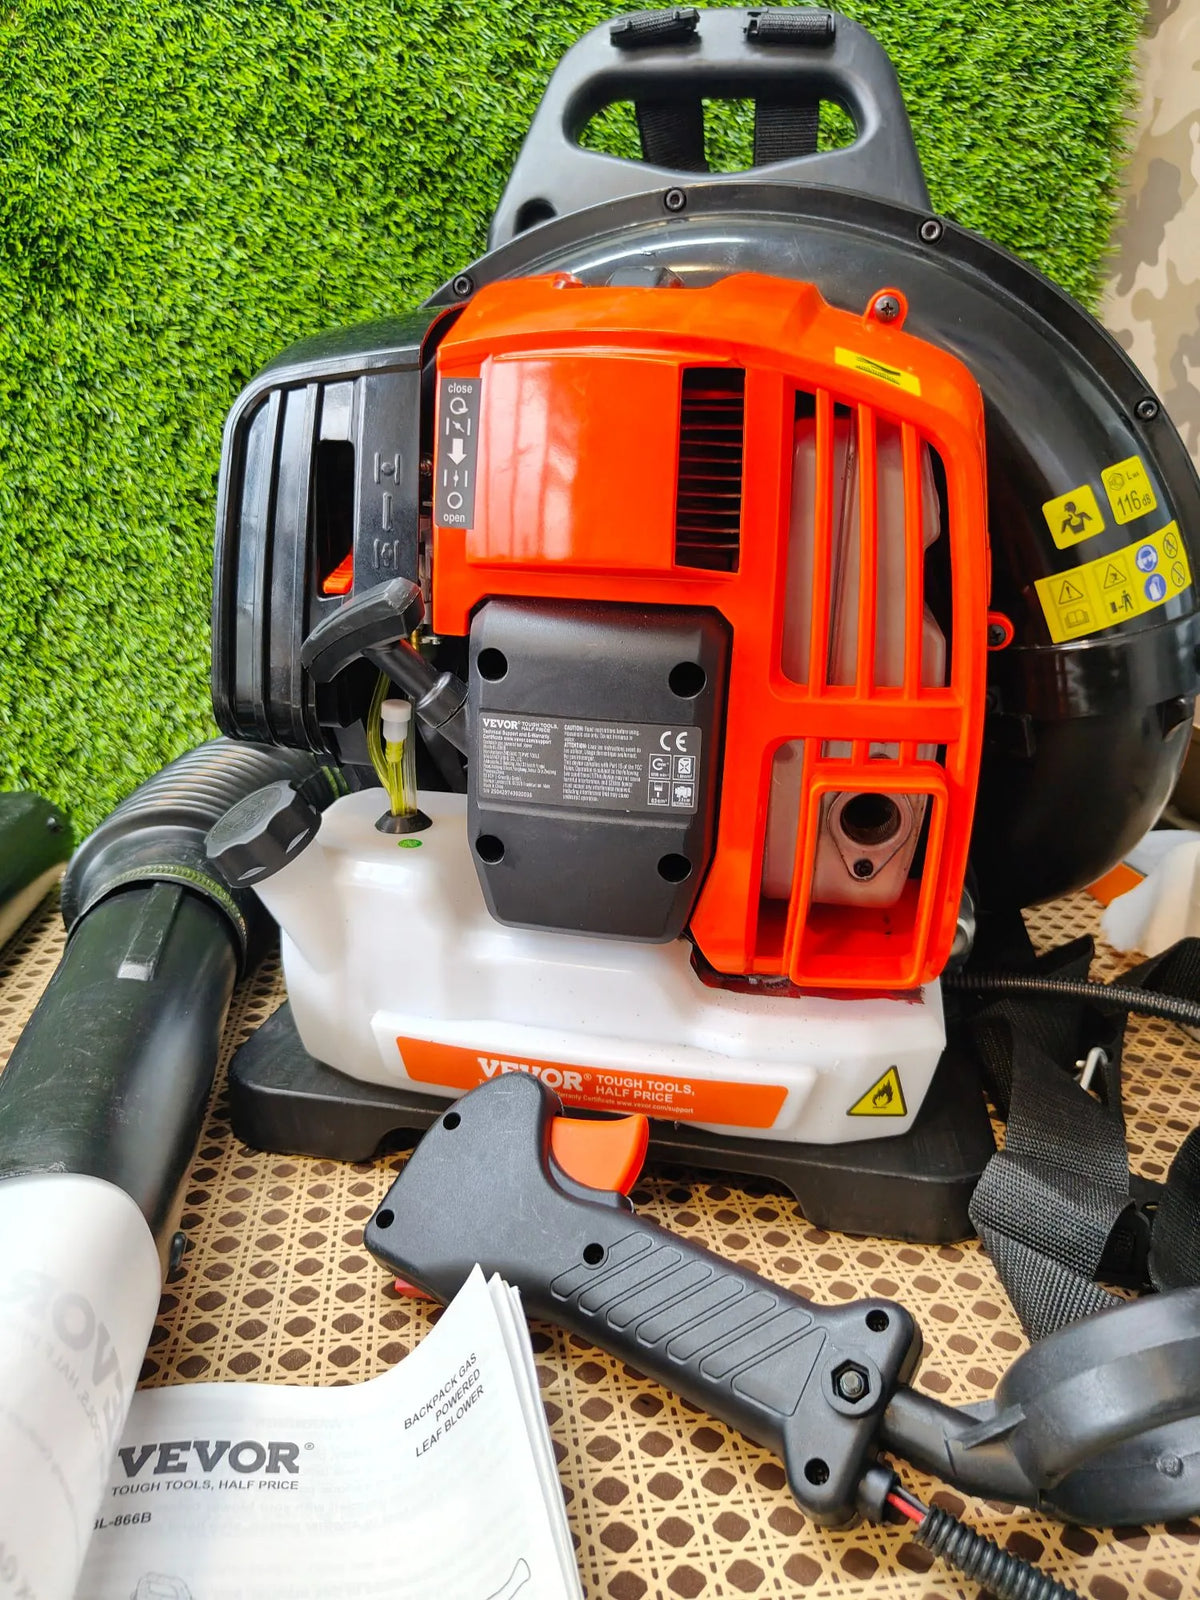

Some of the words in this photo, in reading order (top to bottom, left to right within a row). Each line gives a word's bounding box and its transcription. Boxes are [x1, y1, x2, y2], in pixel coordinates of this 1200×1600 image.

[448, 383, 473, 394] close
[1117, 490, 1142, 516] 116
[443, 513, 466, 524] open
[483, 718, 518, 730] VEVOR
[659, 730, 688, 752] CE
[595, 1085, 630, 1097] HALF
[633, 1090, 673, 1103] PRICE
[596, 1074, 643, 1089] TOUGH
[646, 1080, 695, 1096] TOOLS,
[583, 1095, 615, 1105] Certificate
[616, 1100, 694, 1114] www.vevor.com/support
[404, 1374, 458, 1430] BACKPACK
[458, 1352, 478, 1378] GAS
[435, 1368, 481, 1422] POWERED
[415, 1427, 443, 1458] LEAF
[444, 1384, 484, 1432] BLOWER
[111, 1481, 161, 1497] TOUGH
[164, 1480, 215, 1492] TOOLS,
[218, 1480, 255, 1490] HALF
[258, 1480, 299, 1491] PRICE
